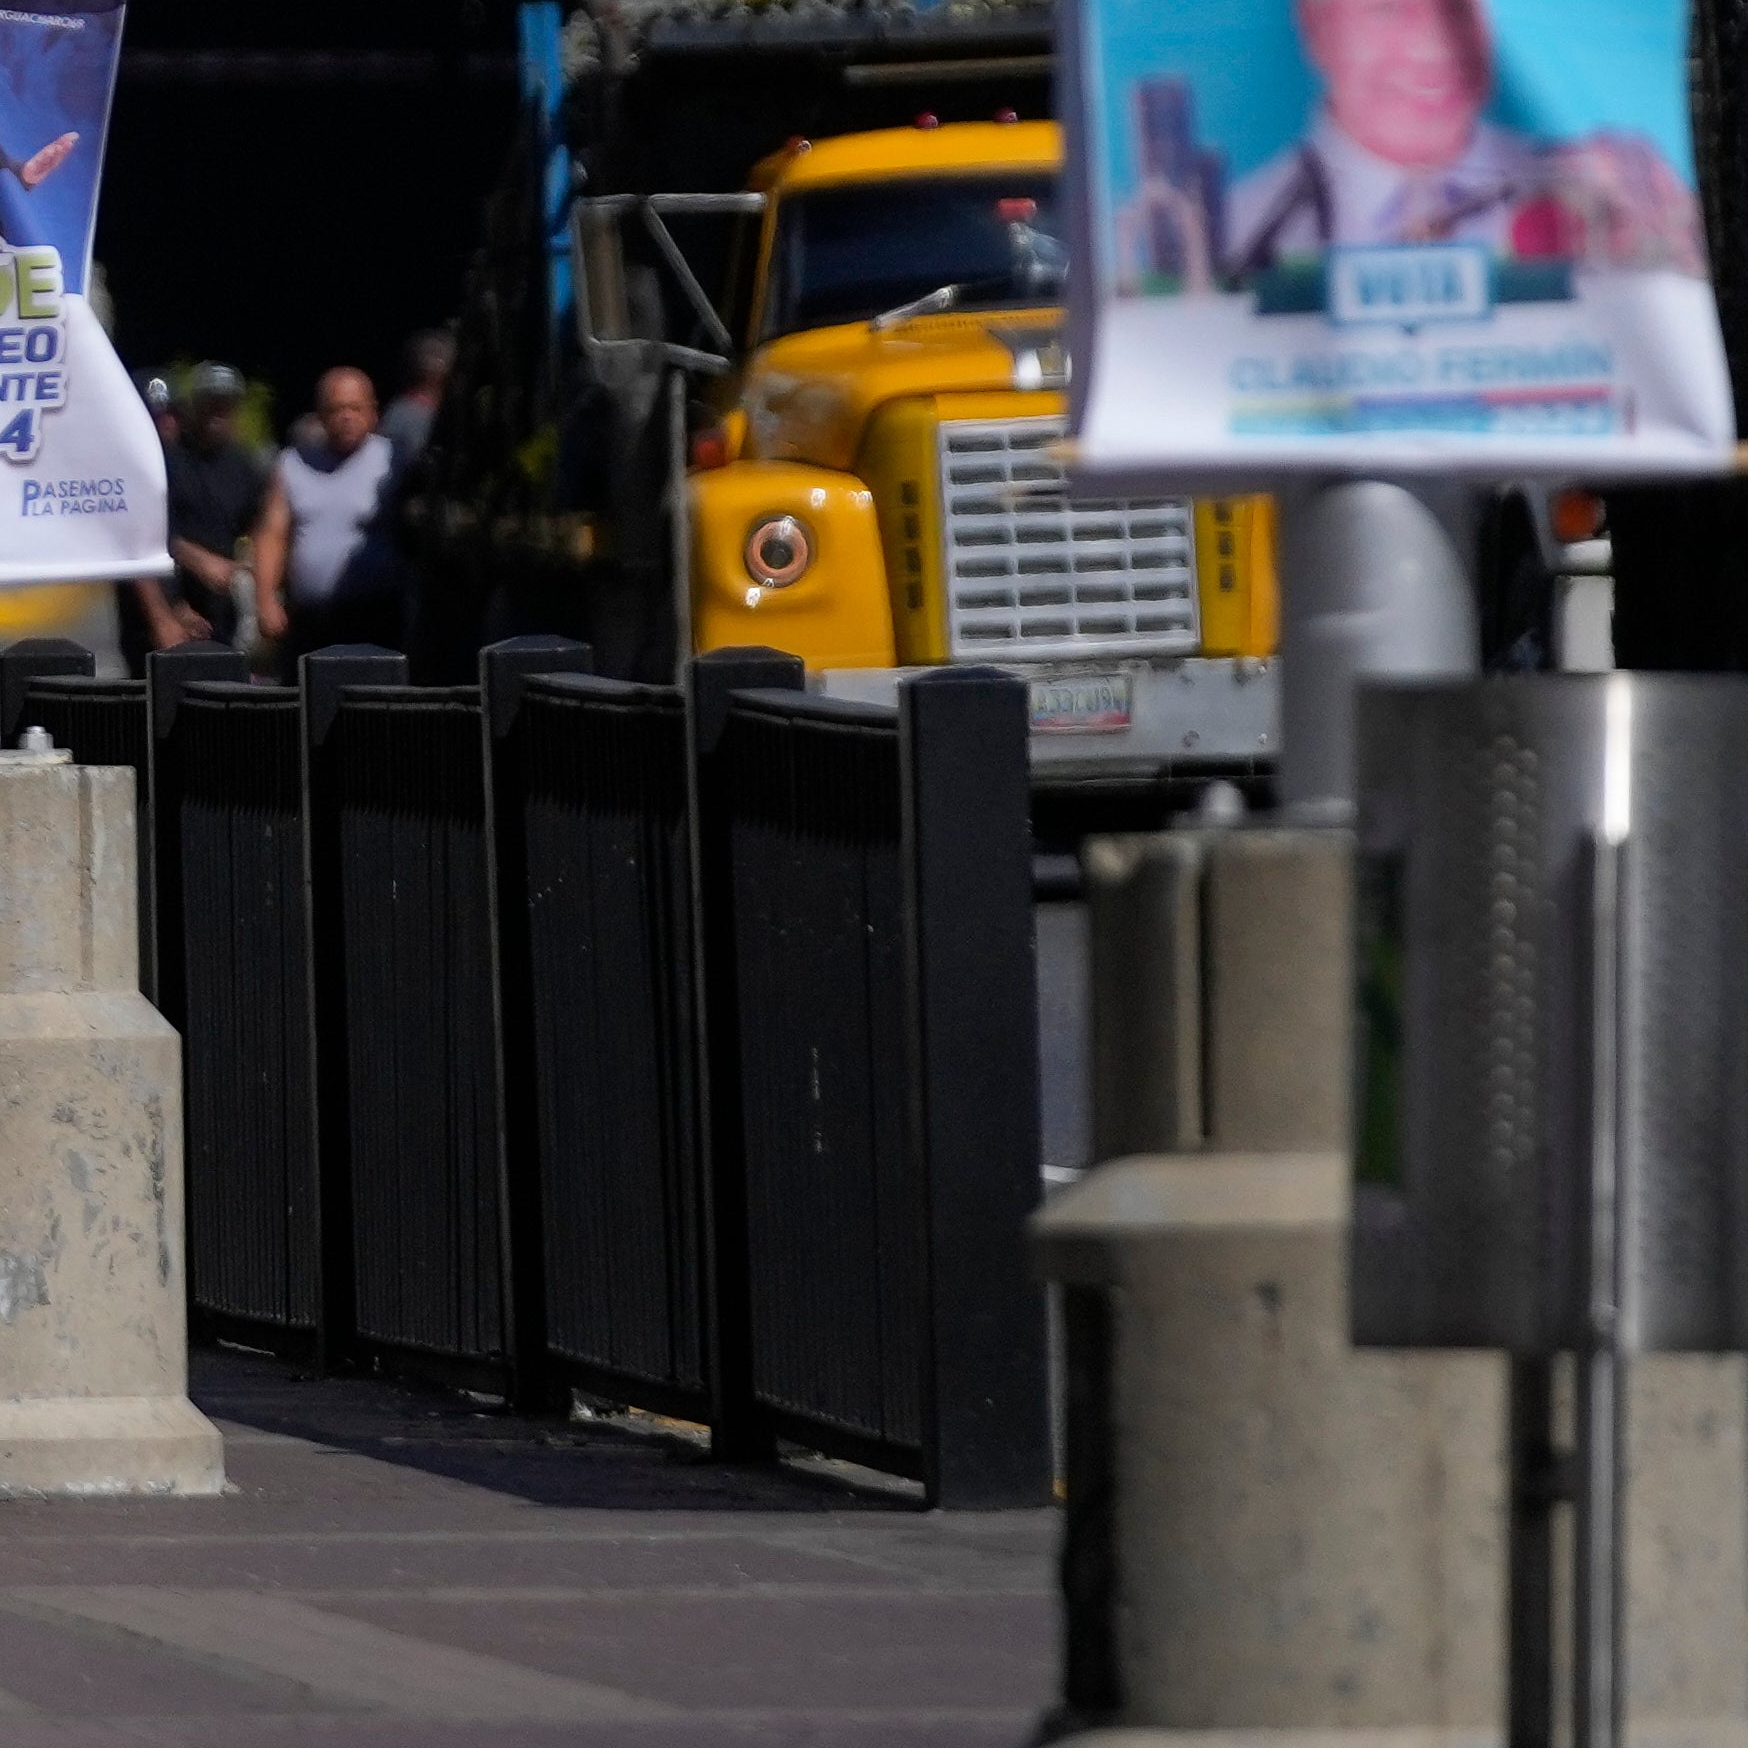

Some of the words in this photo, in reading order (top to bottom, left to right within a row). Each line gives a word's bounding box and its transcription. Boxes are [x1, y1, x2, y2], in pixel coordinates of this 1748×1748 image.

[21, 478, 125, 516] PASEMOS
[32, 501, 54, 516] LA
[60, 499, 129, 514] PAGINA
